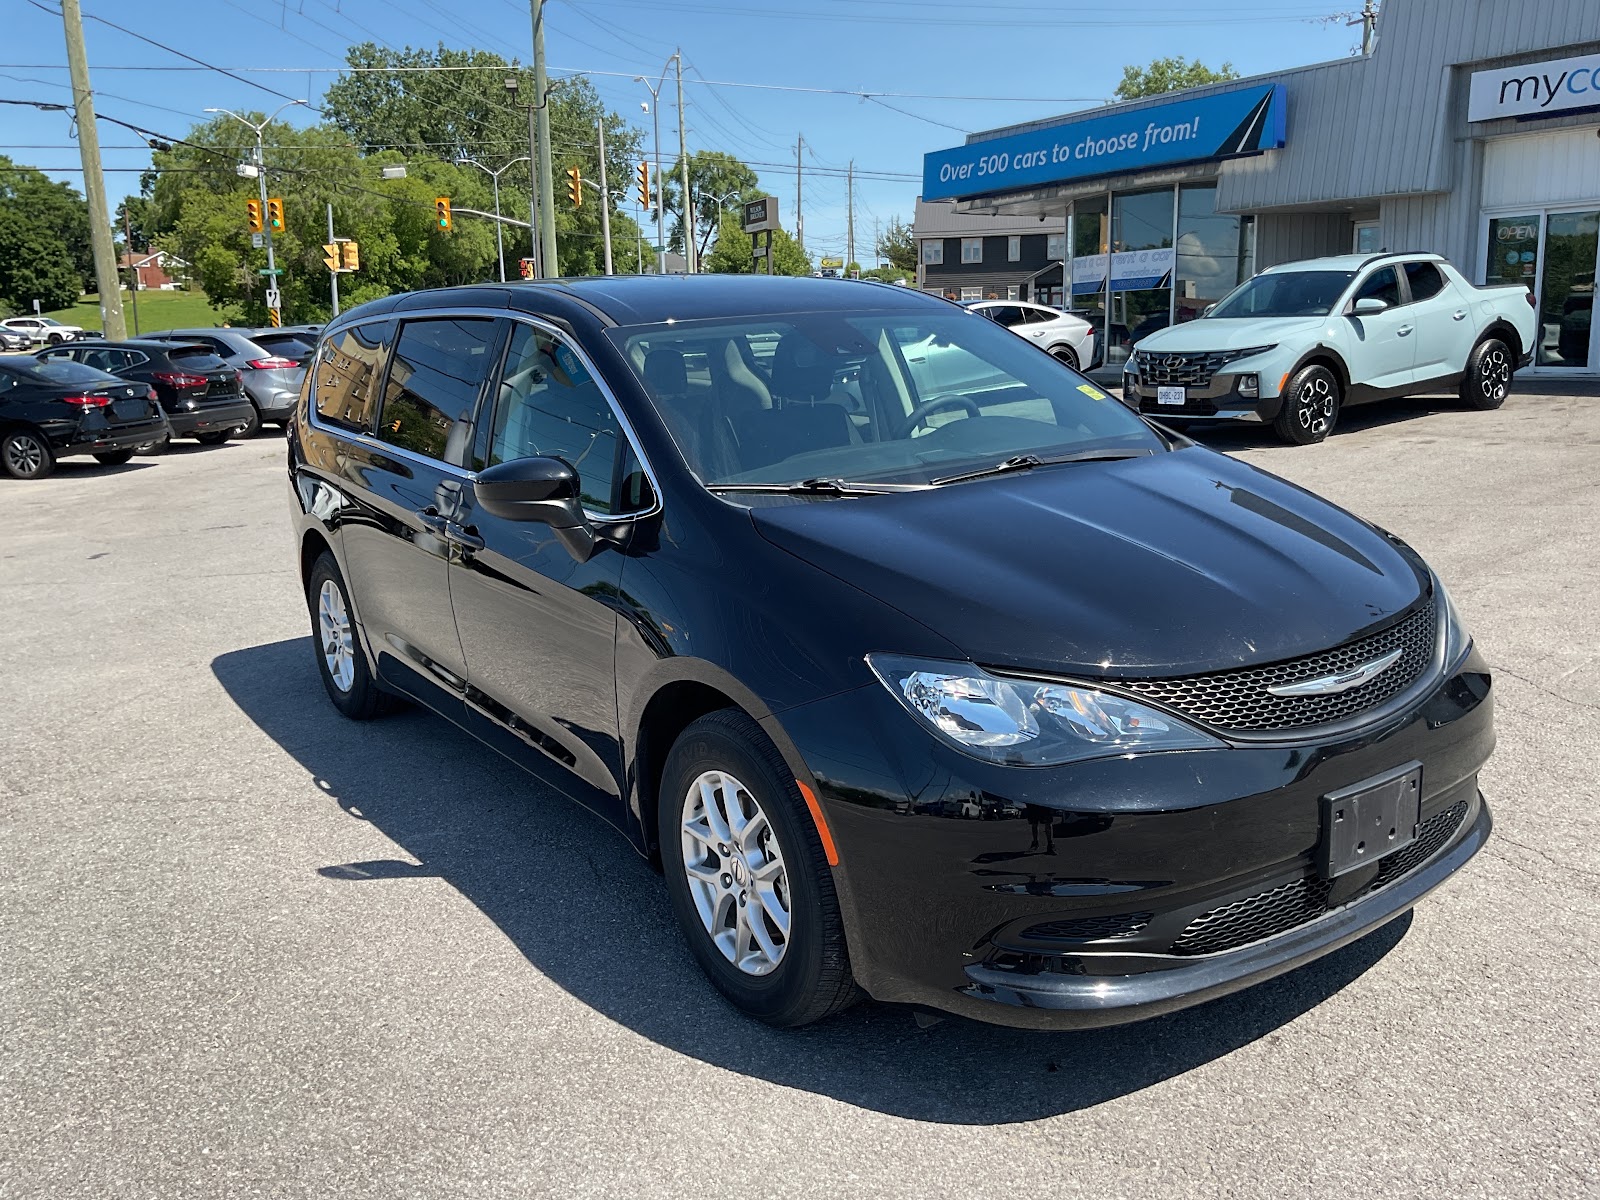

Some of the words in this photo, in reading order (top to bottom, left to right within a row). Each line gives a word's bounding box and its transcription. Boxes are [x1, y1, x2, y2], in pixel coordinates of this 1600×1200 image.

[939, 162, 975, 183] Over
[977, 153, 1009, 176] 500
[1013, 149, 1048, 170] cars
[1052, 143, 1070, 164] to
[1074, 135, 1138, 160] choose
[1142, 116, 1200, 152] from!
[1497, 224, 1537, 240] OPEN
